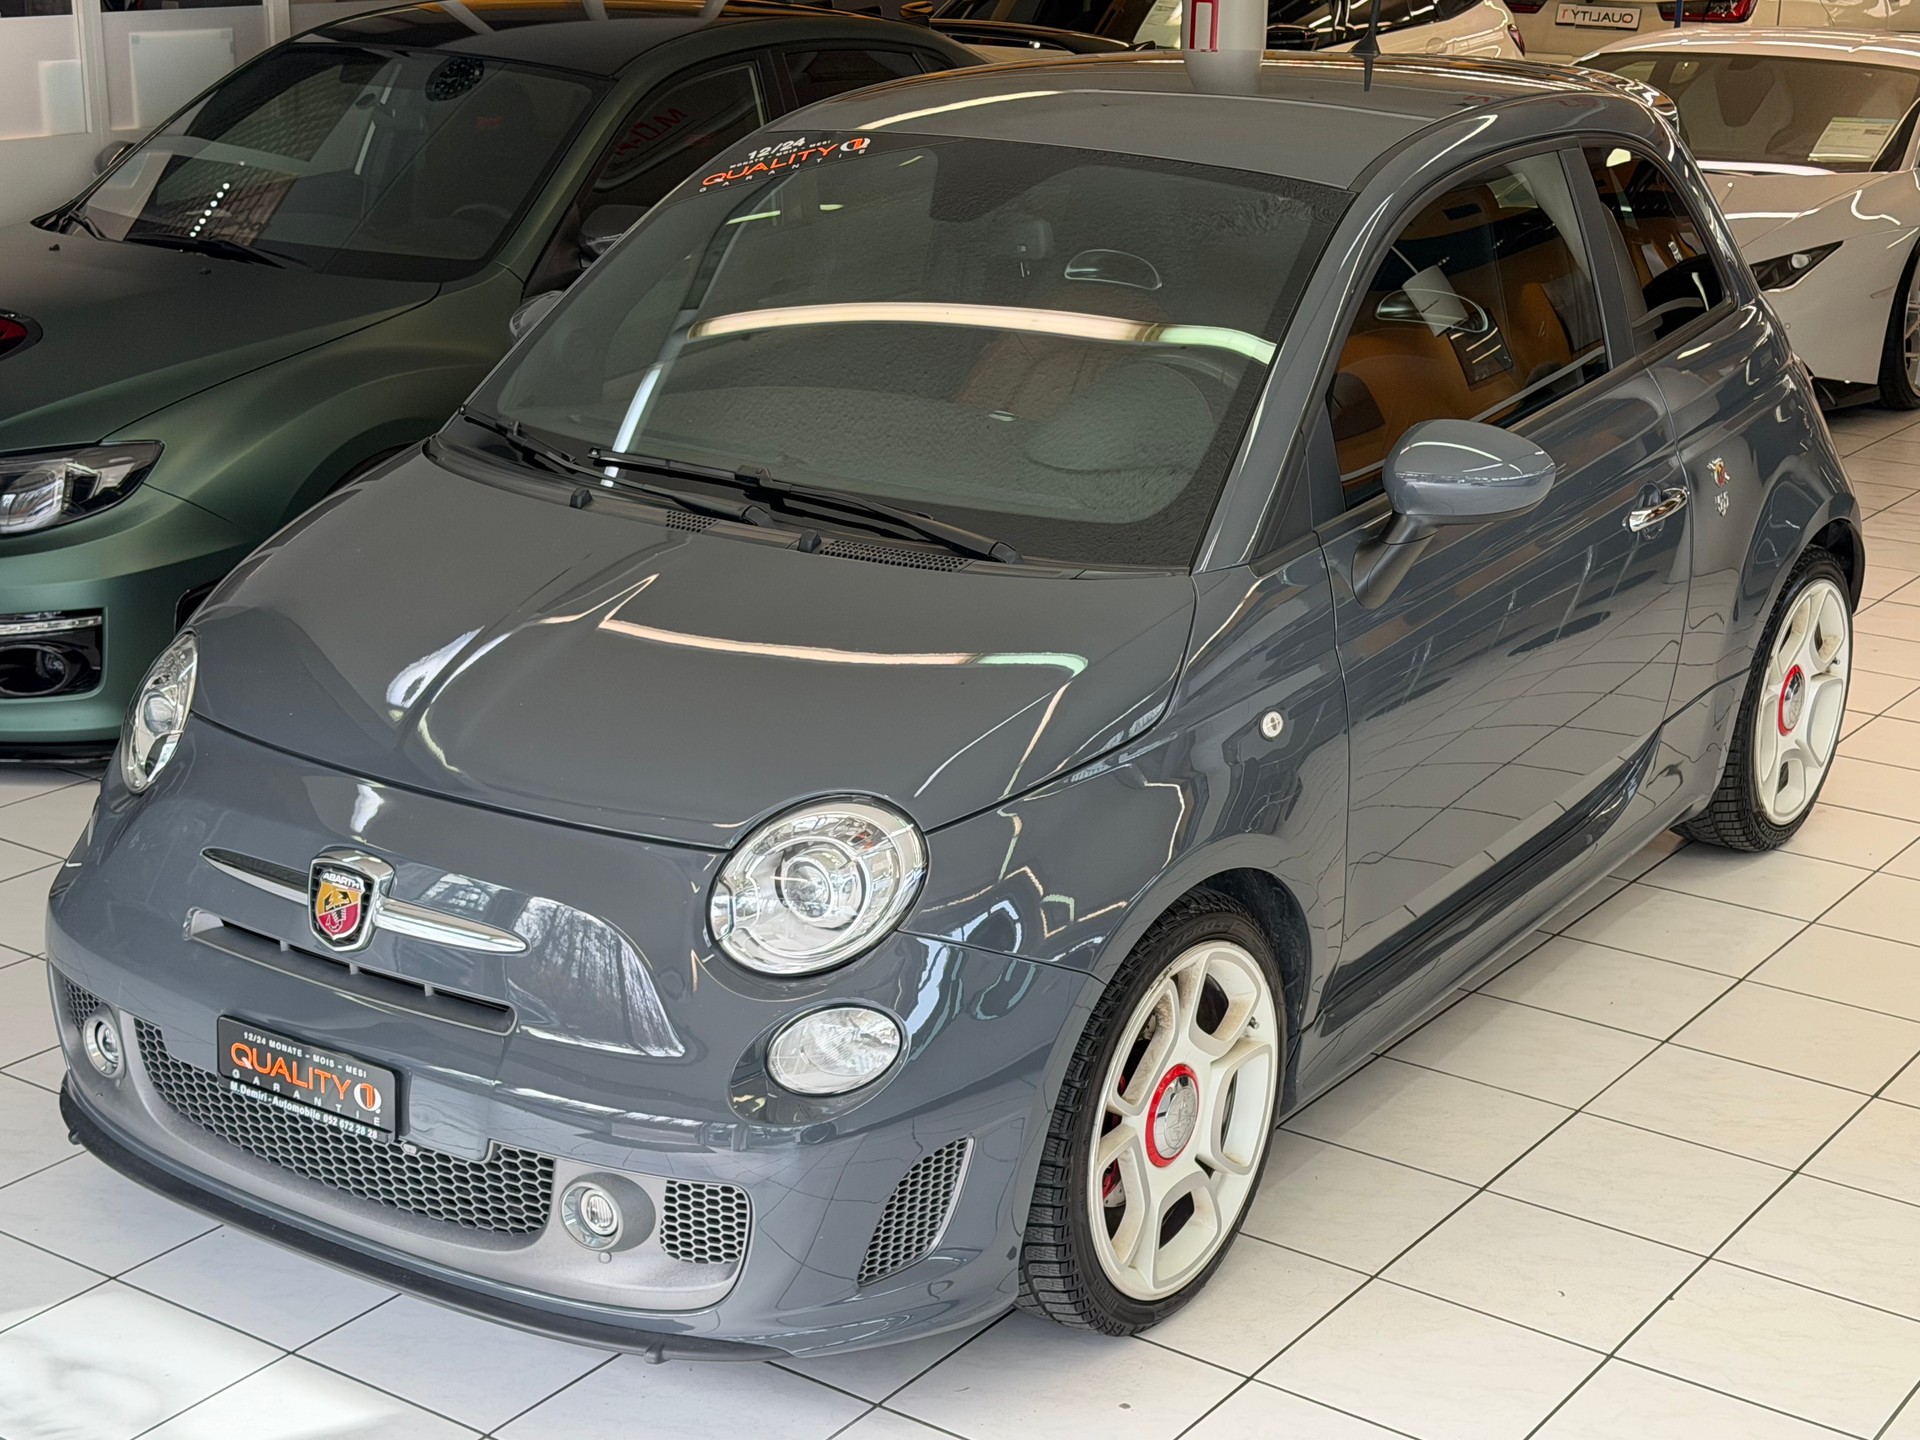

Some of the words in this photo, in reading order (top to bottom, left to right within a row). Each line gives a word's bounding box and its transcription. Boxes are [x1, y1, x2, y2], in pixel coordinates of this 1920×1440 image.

[699, 148, 866, 193] GARANTIE
[702, 143, 839, 186] QUALITY
[748, 137, 806, 160] 12/24
[322, 872, 360, 889] ABARTH
[231, 1042, 352, 1101] QUALITY
[243, 1031, 267, 1045] 12/24
[268, 1039, 303, 1058] MONATE
[312, 1054, 335, 1068] MOIS
[345, 1064, 367, 1079] MESI
[232, 1068, 381, 1127] GARANTIE
[323, 1113, 338, 1126] 052
[339, 1119, 354, 1132] 672
